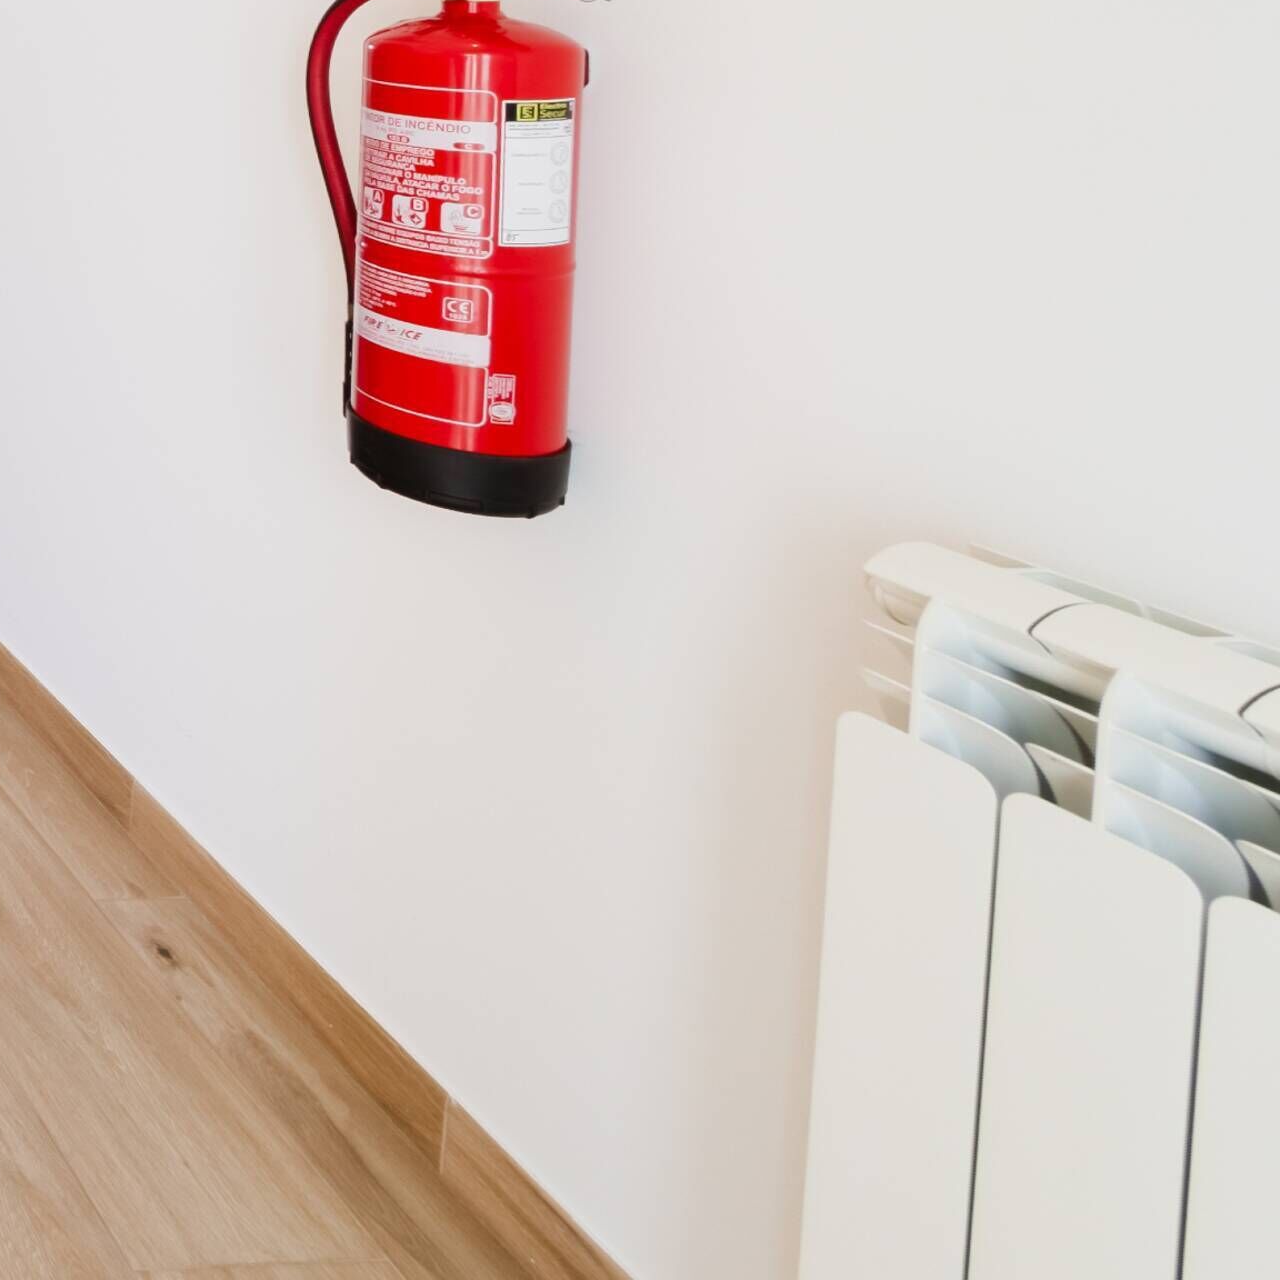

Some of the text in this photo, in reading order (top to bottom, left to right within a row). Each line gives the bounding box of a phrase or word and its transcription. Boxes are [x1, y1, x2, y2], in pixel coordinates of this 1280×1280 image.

[387, 116, 401, 128] DE
[391, 142, 435, 158] EMPREGO
[395, 152, 435, 167] CAVILHA
[404, 171, 412, 179] O
[396, 185, 415, 196] DAS
[416, 188, 460, 201] CHAMAS
[402, 179, 484, 195] ATACAR O FOGO
[374, 191, 382, 202] A
[413, 199, 424, 211] B
[467, 205, 479, 217] C
[446, 300, 470, 313] CE
[400, 328, 423, 341] ICE
